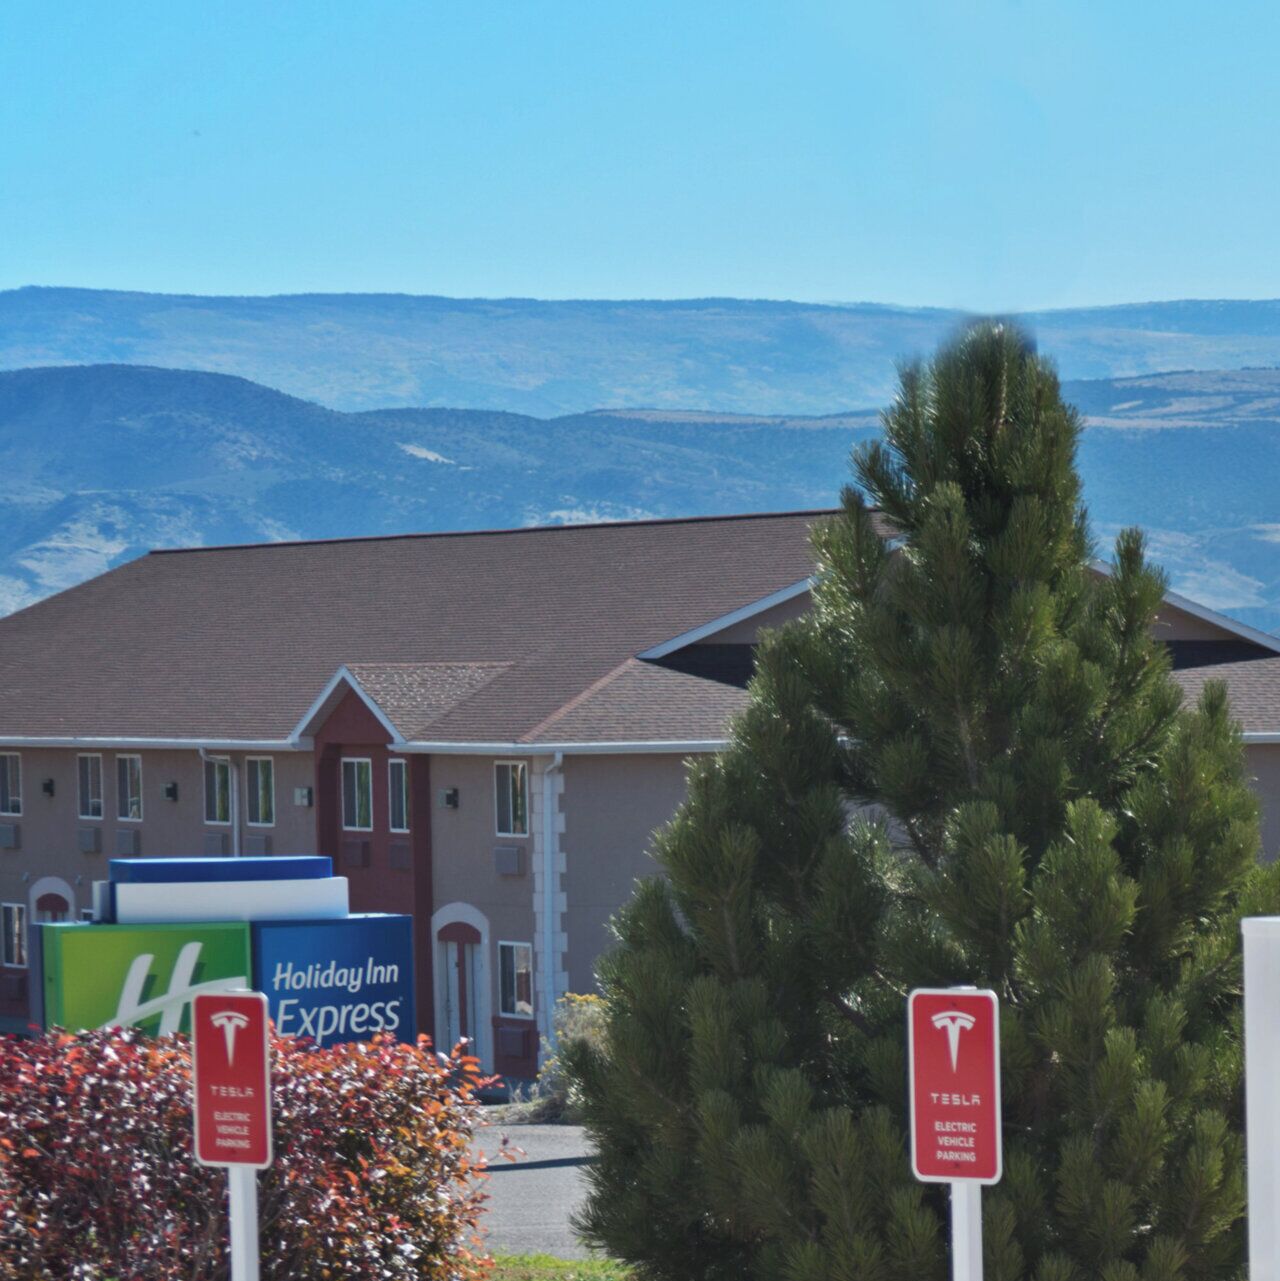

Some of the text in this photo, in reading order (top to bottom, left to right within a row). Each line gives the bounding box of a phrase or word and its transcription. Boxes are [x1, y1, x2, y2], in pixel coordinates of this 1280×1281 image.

[273, 957, 399, 993] Holiday Inn
[276, 999, 400, 1045] Express
[210, 1085, 254, 1097] TESLA
[931, 1092, 980, 1106] TESLA
[214, 1111, 251, 1121] ELECTRIC
[216, 1125, 250, 1136] VEHICLE
[935, 1121, 977, 1133] ELECTRIC
[215, 1138, 251, 1149] PARKING
[938, 1136, 975, 1148] VEHICLE
[936, 1151, 976, 1162] PARKING
